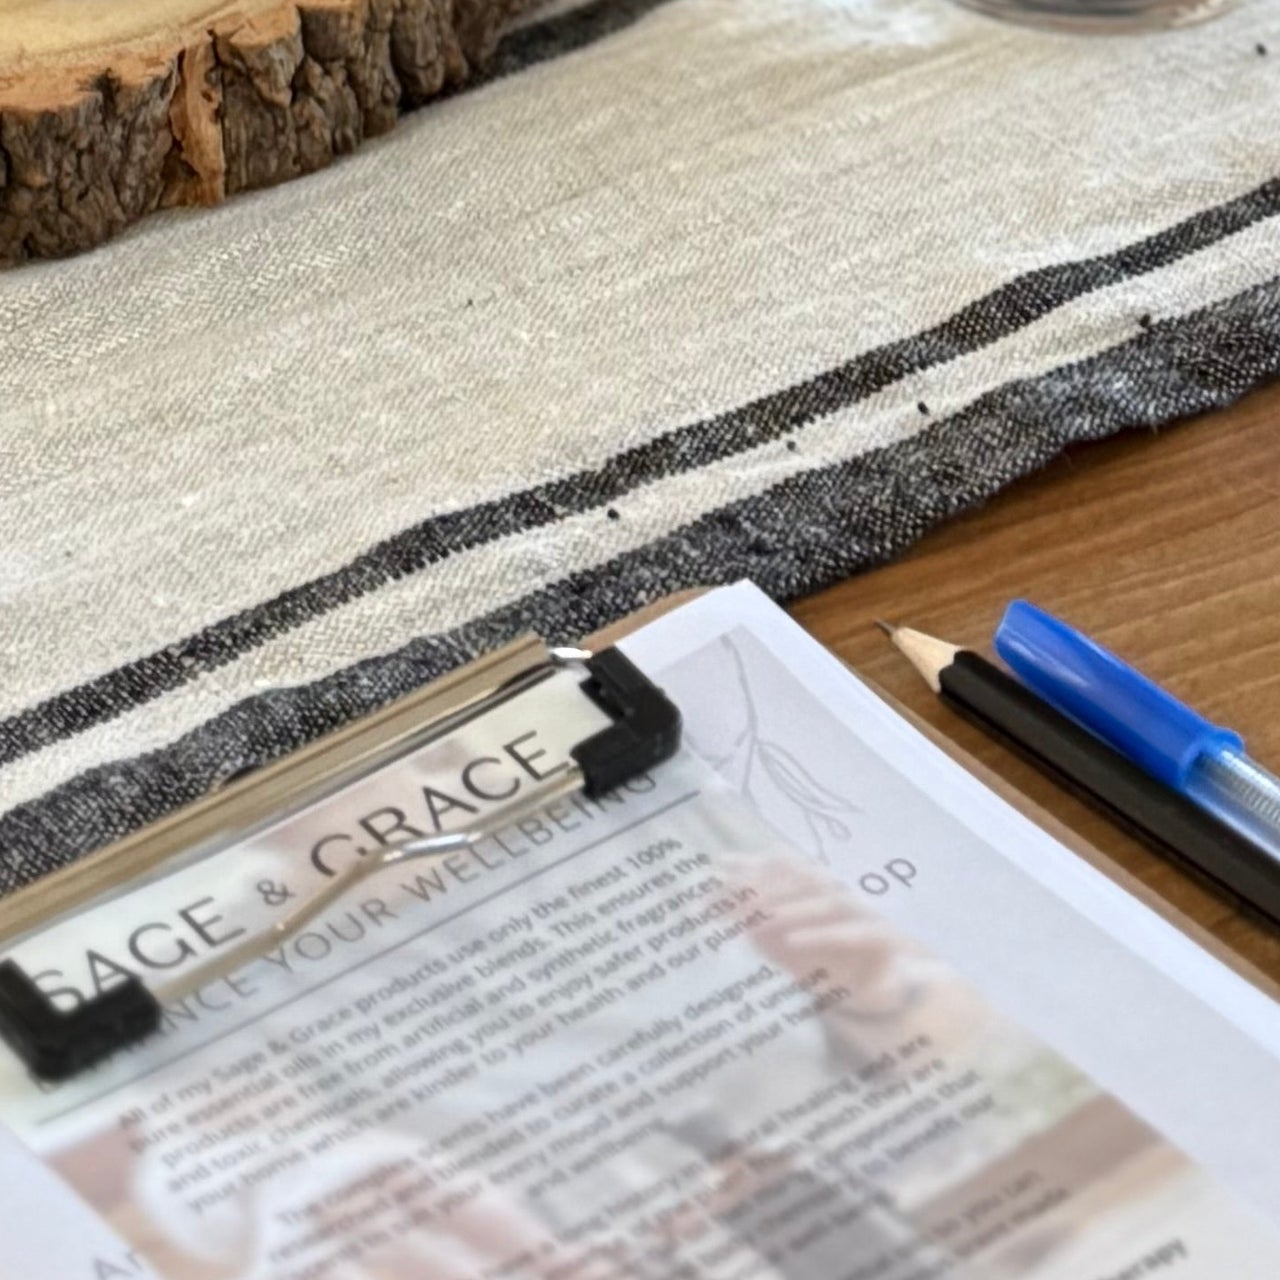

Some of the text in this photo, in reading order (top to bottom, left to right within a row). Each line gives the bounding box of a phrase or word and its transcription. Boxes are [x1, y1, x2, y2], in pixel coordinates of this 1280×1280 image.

[29, 729, 570, 1016] SAGE & GRACE
[263, 900, 399, 976] YOUR
